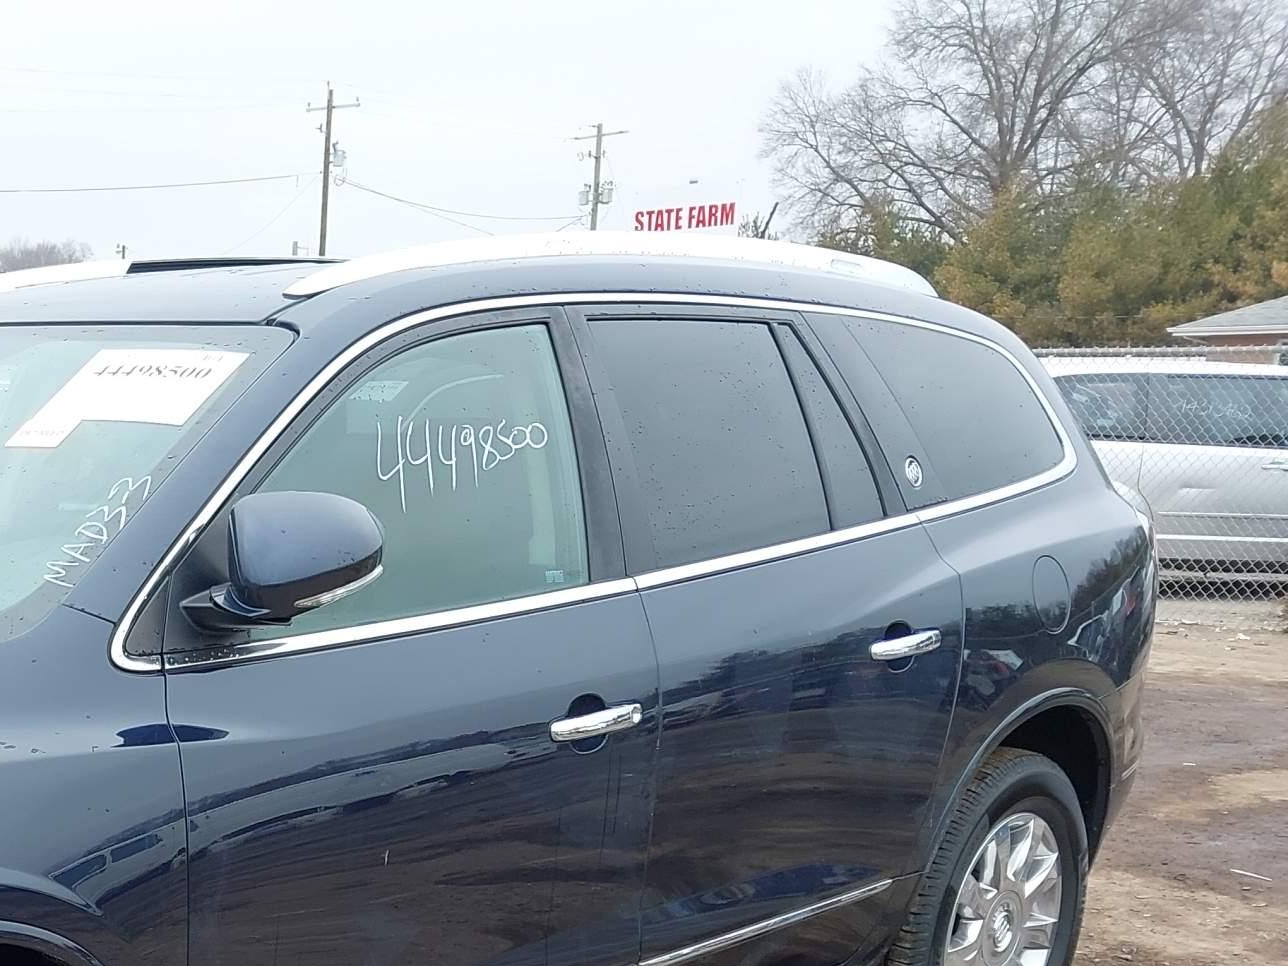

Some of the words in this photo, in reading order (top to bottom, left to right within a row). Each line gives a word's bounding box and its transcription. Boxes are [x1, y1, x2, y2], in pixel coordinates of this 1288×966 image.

[634, 207, 683, 231] STATE
[687, 202, 736, 229] FARM
[93, 364, 212, 379] 44498500
[376, 415, 548, 514] 44498500
